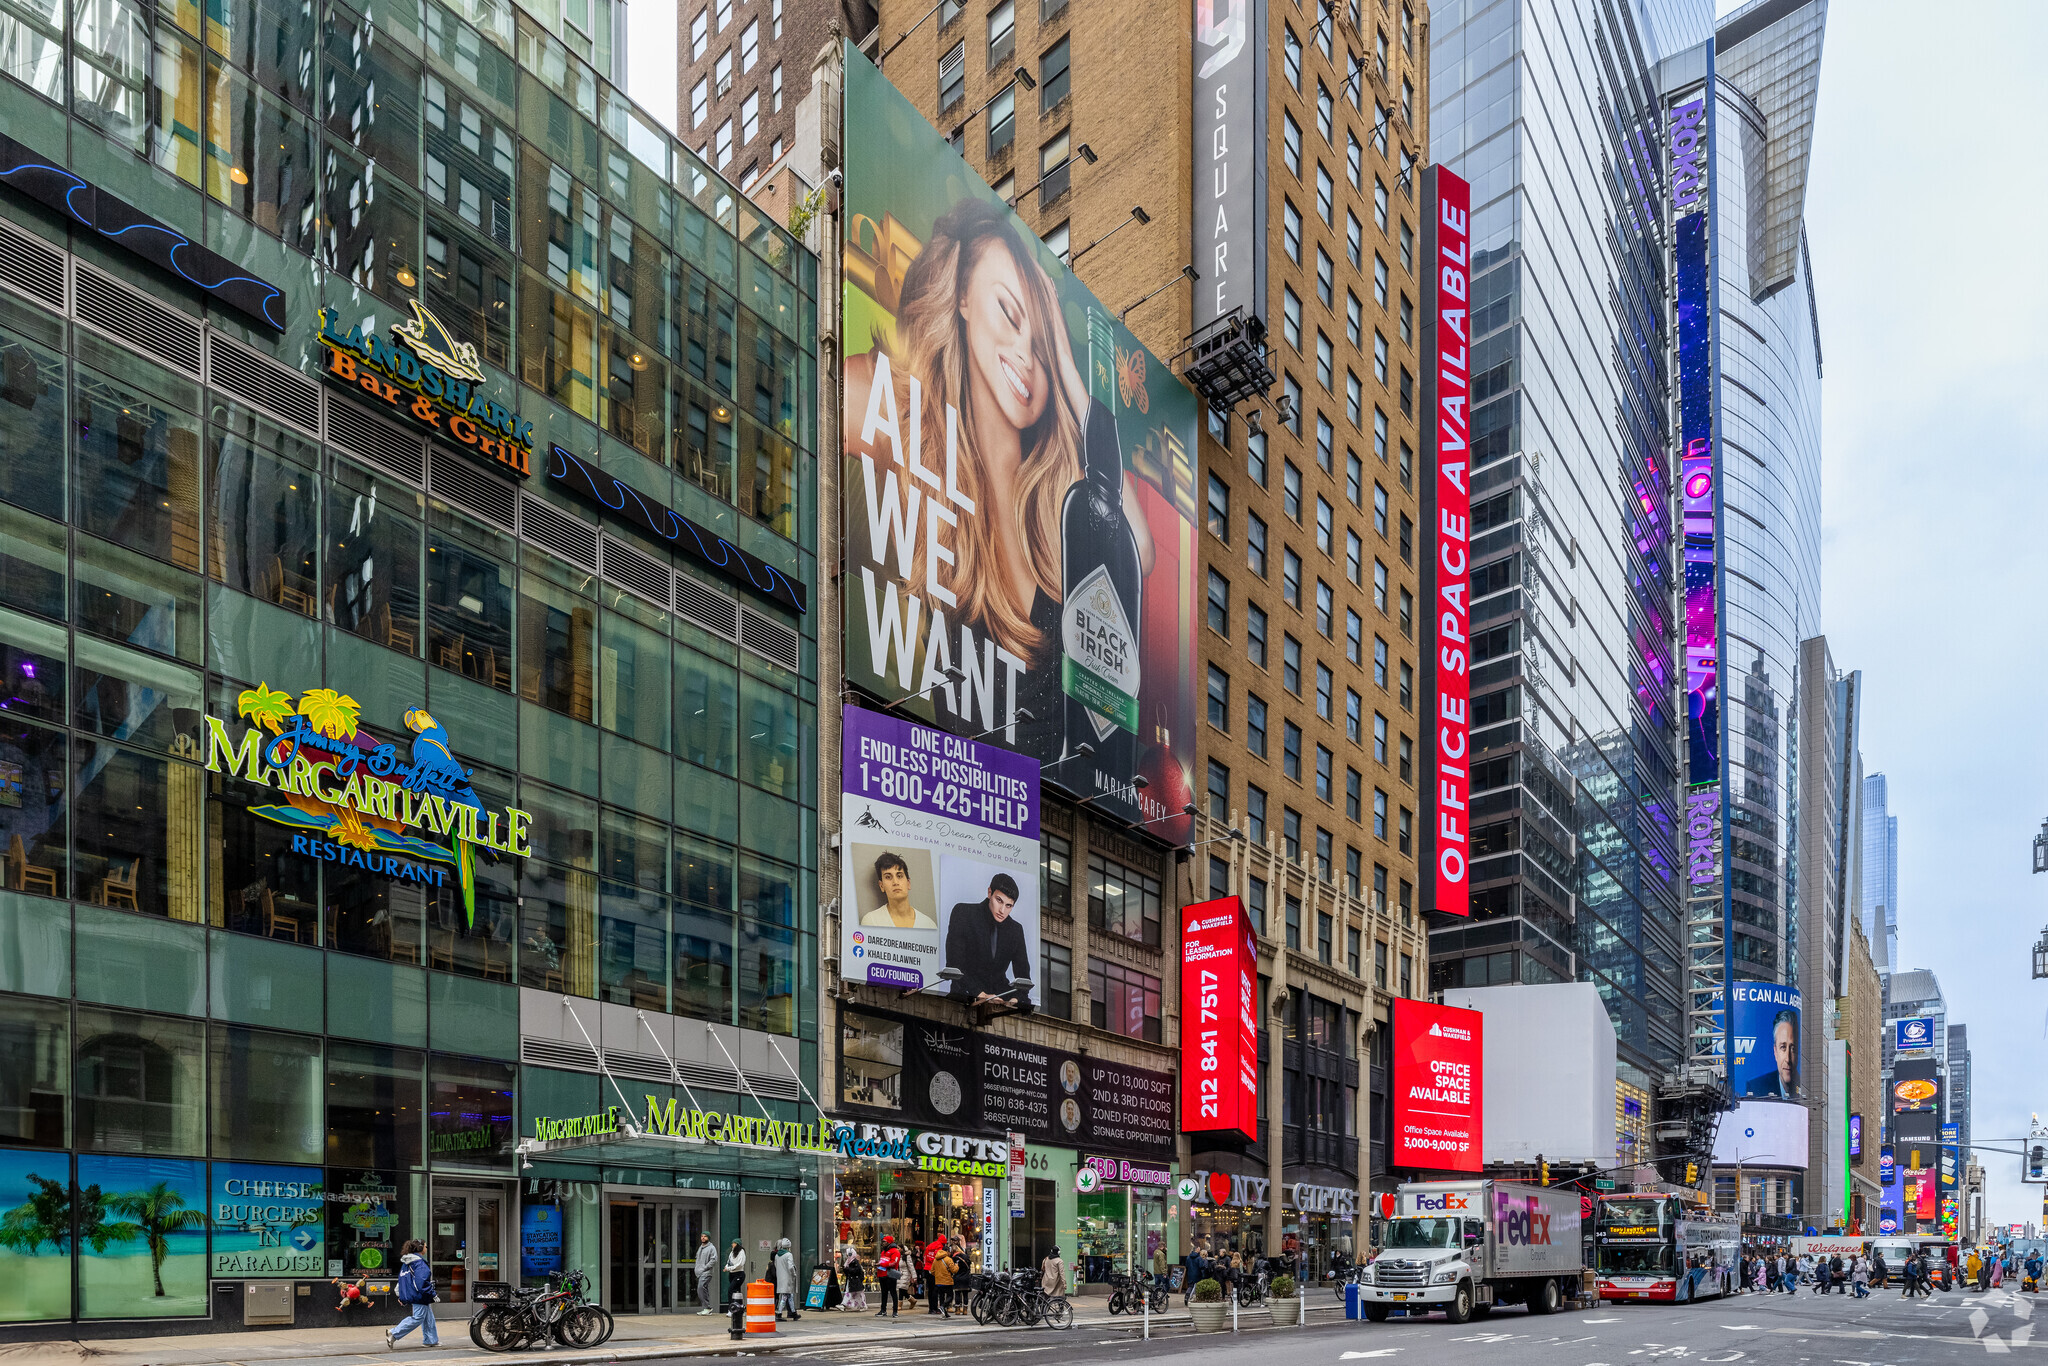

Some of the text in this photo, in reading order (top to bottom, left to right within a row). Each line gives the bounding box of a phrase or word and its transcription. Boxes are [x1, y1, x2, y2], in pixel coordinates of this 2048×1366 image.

[1214, 84, 1228, 316] SQUARE
[319, 307, 534, 451] LANDSHARK
[330, 347, 531, 476] Bar & Grill
[860, 351, 975, 516] ALL
[861, 452, 957, 608] WE
[1440, 198, 1466, 883] OFFICE SPACE AVAILABLE
[1076, 608, 1128, 659] BLACK
[861, 566, 1026, 746] WANT
[1080, 632, 1123, 675] IRISH
[265, 715, 473, 796] Jimmy Buffett's
[911, 726, 983, 768] ONE CALL,
[860, 736, 1028, 801] ENDLESS POSSIBILITIES
[205, 714, 533, 858] MARGARITAVILLE
[859, 762, 1029, 831] 1-800-425-HELP
[1095, 769, 1167, 822] MARIAH CAREY
[891, 811, 1022, 857] Dare 2 Dream Recovery
[891, 830, 911, 840] YOUR
[988, 852, 1002, 860] OUR
[1004, 856, 1028, 866] DREAM
[293, 835, 447, 887] RESTAURANT
[1202, 916, 1227, 925] CUSHMAN
[1202, 920, 1233, 930] WAKEFIELD
[867, 935, 938, 955] DARE2DREAMRECOVERY
[1186, 940, 1199, 948] FOR
[1186, 944, 1214, 955] LEASING
[1186, 948, 1232, 962] INFORMATION
[867, 950, 921, 966] KHALED ALAWNEH
[871, 966, 920, 984] CEO/FOUNDER
[1749, 989, 1771, 1002] CAN
[1774, 991, 1788, 1005] ALL
[1443, 1026, 1466, 1035] CUSHMAN
[1443, 1032, 1471, 1041] WAKEFIELD
[984, 1044, 1047, 1066] 566 7TH AVENUE
[1201, 970, 1218, 1118] 212 841 7517
[984, 1062, 1047, 1087] FOR LEASE
[1430, 1060, 1470, 1077] OFFICE
[1093, 1068, 1171, 1095] UP TO 13,000 SQFT
[1435, 1075, 1470, 1090] SPACE
[984, 1094, 1048, 1114] (516) 636-4375
[1092, 1088, 1171, 1113] 2ND & 3RD FLOORS
[1409, 1086, 1470, 1104] AVAILABLE
[535, 1106, 618, 1141] MARGARITAVILLE
[645, 1094, 834, 1152] MARGARITAVILLE
[984, 1112, 1048, 1128] 566SEVENTH.COM
[1092, 1108, 1171, 1130] ZONED FOR SCHOOL
[1404, 1125, 1469, 1138] Office Space Available
[836, 1126, 912, 1160] Resort
[916, 1132, 1007, 1162] GIFTS
[1093, 1126, 1171, 1146] SIGNAGE OPPORTUNITY
[1404, 1137, 1469, 1152] 3,000-9,000 SF
[918, 1156, 1007, 1178] LUGGAGE
[1088, 1157, 1170, 1184] CBD BOUTIQUE
[225, 1179, 312, 1198] CHEESE
[1195, 1170, 1354, 1216] I NY GIFTS
[218, 1204, 319, 1223] BURGERS
[1417, 1193, 1468, 1210] FedEx
[1498, 1192, 1551, 1246] FedEx
[258, 1230, 281, 1247] IN
[216, 1256, 322, 1272] PARADISE
